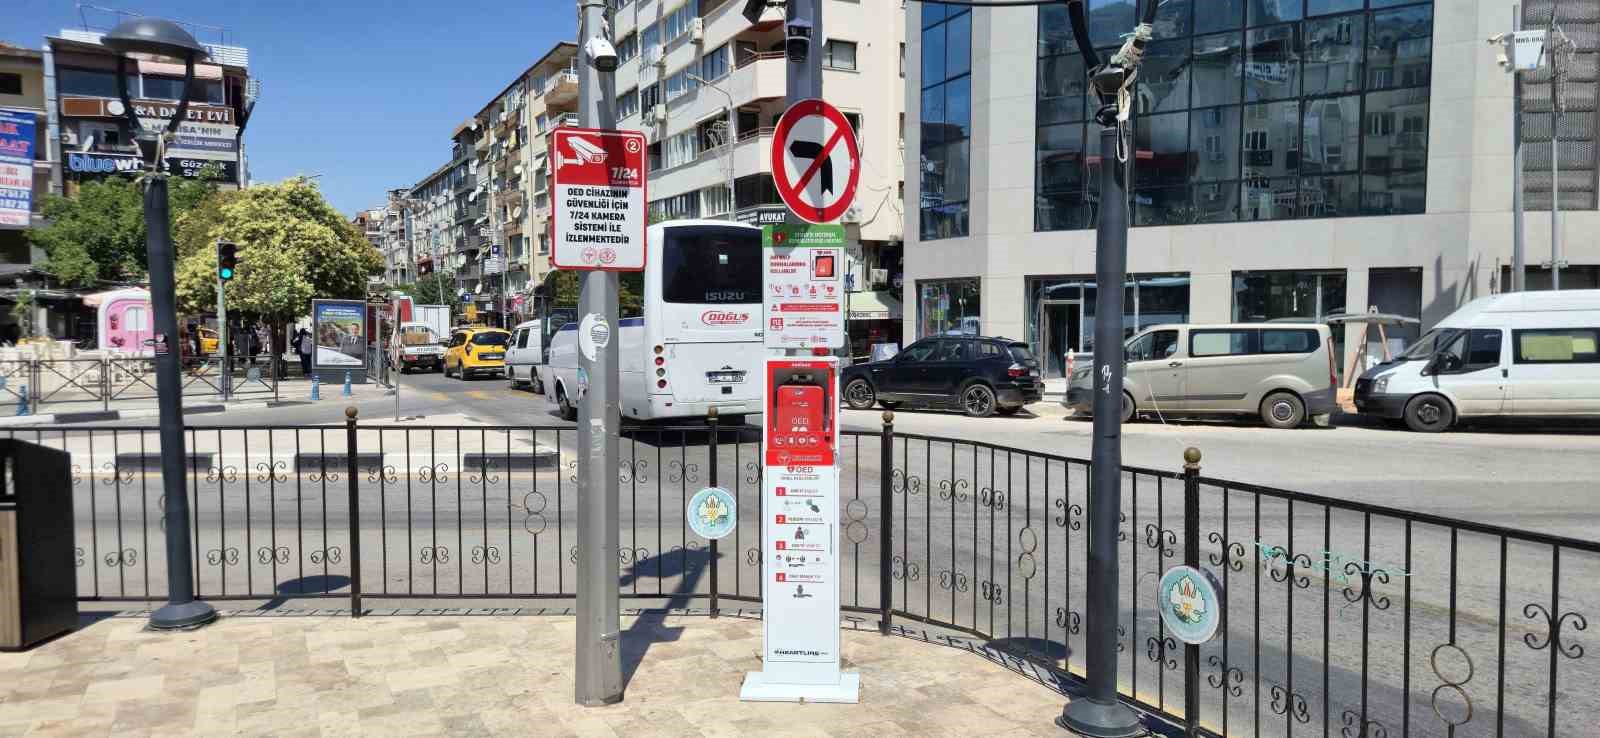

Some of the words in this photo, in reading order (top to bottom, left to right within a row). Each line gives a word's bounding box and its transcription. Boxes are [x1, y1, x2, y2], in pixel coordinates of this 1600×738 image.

[160, 106, 204, 119] DAET
[630, 141, 636, 151] 2
[612, 167, 638, 179] 7/24
[567, 188, 584, 196] OED
[586, 187, 628, 198] CİHAZININ
[566, 198, 610, 209] GÜVENLİĞİ
[611, 200, 629, 211] İÇİN
[569, 211, 590, 220] 7/24
[591, 212, 626, 221] KAMERA
[759, 212, 785, 221] AVUKAT
[574, 222, 607, 232] SİSTEMİ
[609, 224, 622, 233] İLE
[565, 233, 630, 244] İZLENMEKTEDİR
[706, 292, 745, 301] ISUZU
